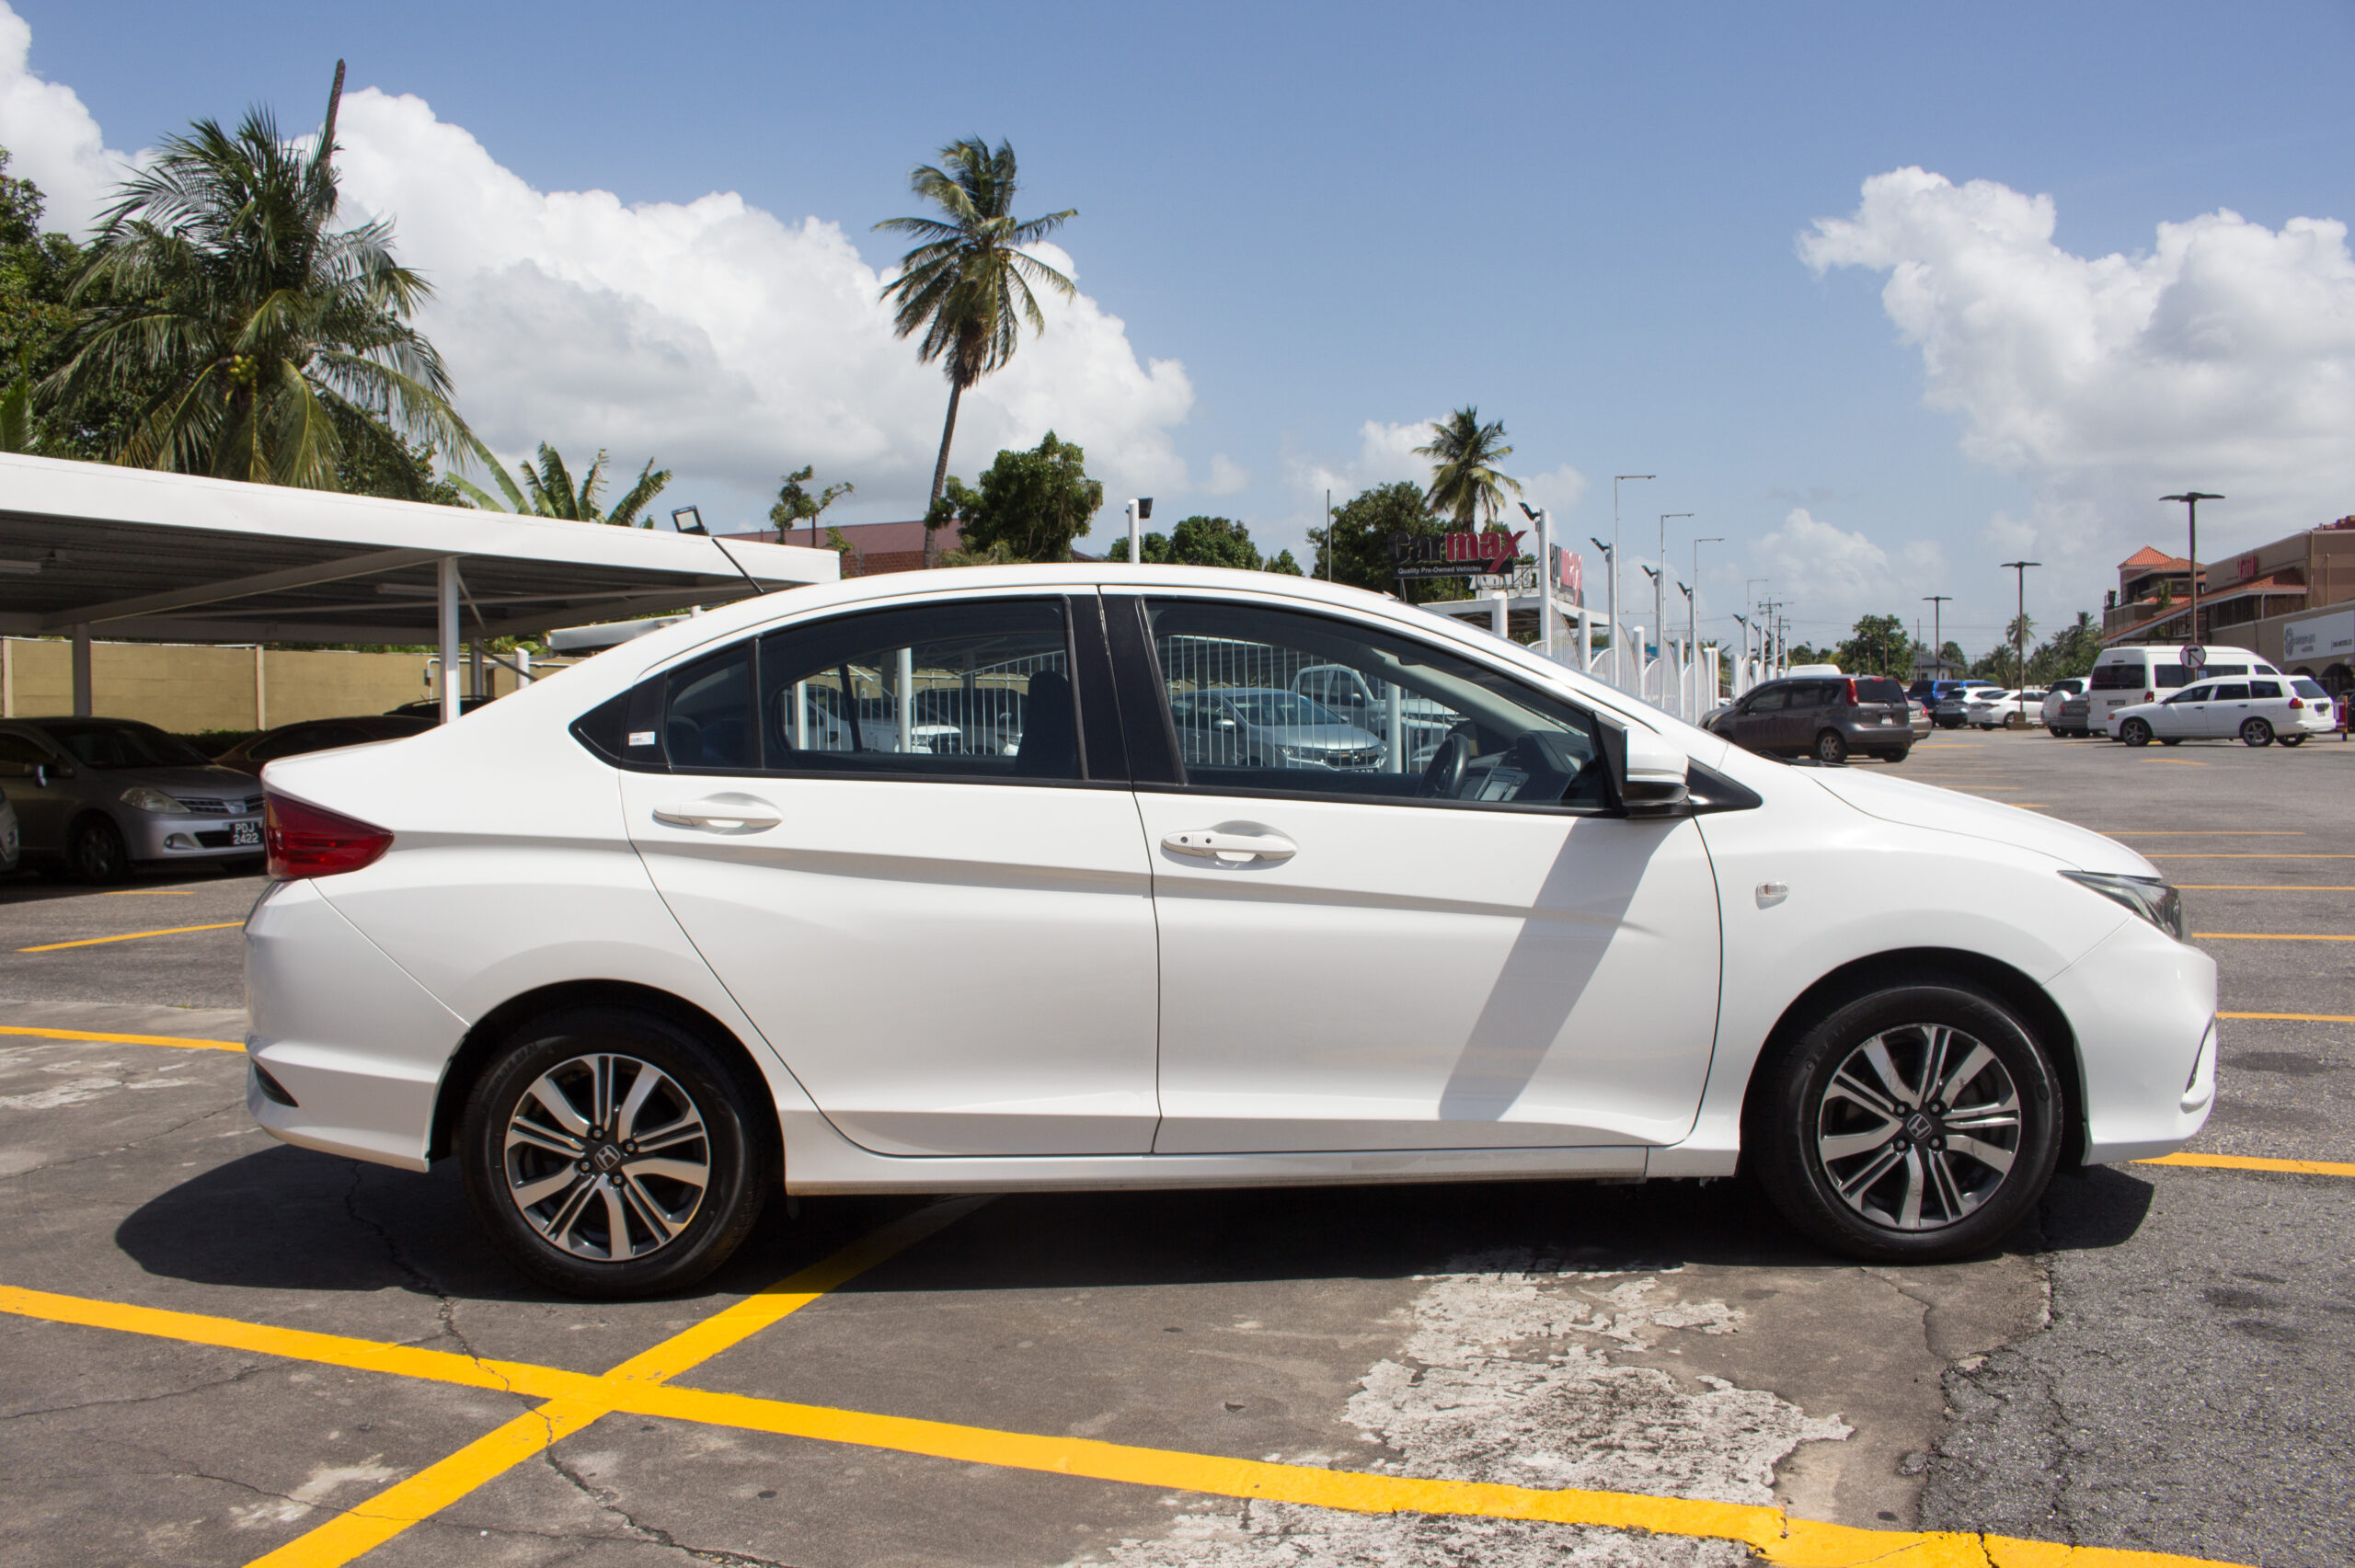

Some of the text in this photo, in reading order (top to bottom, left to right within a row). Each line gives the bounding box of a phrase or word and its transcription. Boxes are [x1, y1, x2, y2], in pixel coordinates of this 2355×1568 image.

[1397, 565, 1482, 576] Quality Pre-Owned Vehicles
[235, 821, 255, 834] PDJ
[233, 832, 259, 845] 2422
